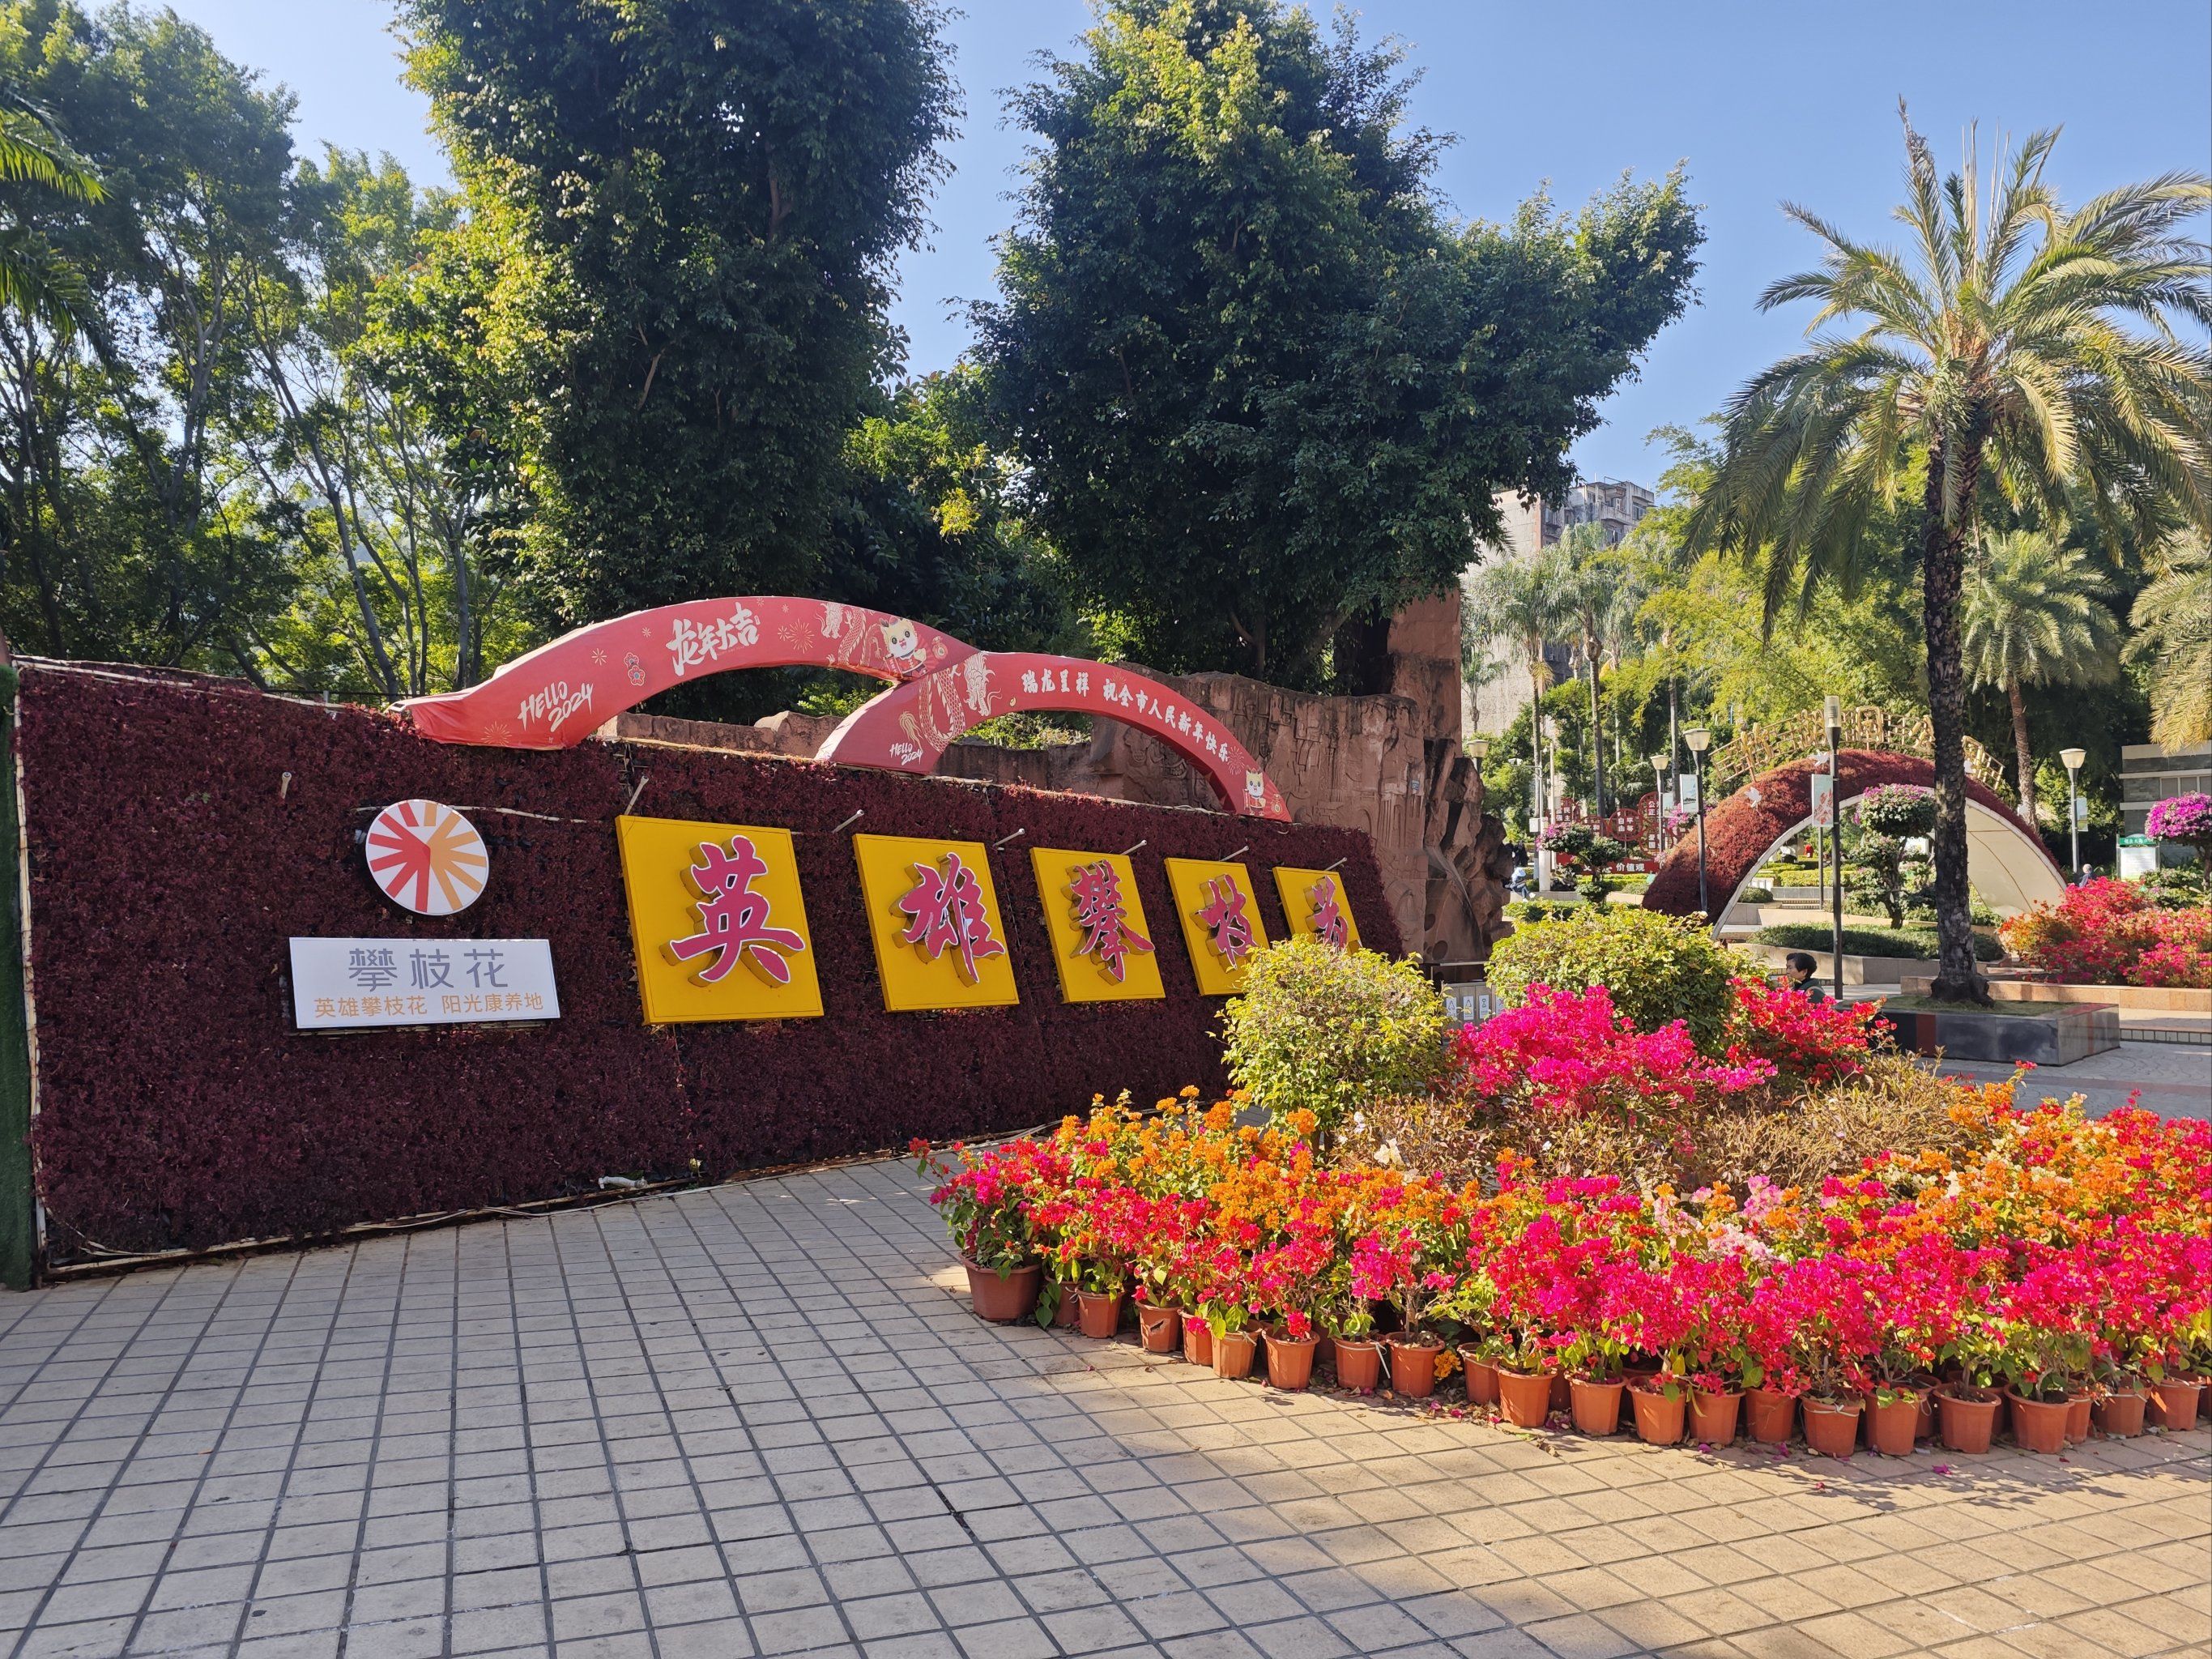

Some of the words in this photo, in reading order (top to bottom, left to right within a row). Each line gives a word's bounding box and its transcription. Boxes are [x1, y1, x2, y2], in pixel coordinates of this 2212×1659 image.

[666, 602, 760, 676] 龙年大吉
[518, 681, 568, 731] HELLO
[548, 683, 594, 732] 2024
[1021, 668, 1090, 697] 瑞龙呈祥
[1103, 679, 1229, 762] 祝全市人民新年快乐
[889, 742, 913, 758] HELLO
[901, 748, 923, 766] 2024
[348, 948, 509, 992] 攀枝花
[313, 996, 428, 1018] 英雄攀枝花
[441, 992, 544, 1014] 阳光康养地
